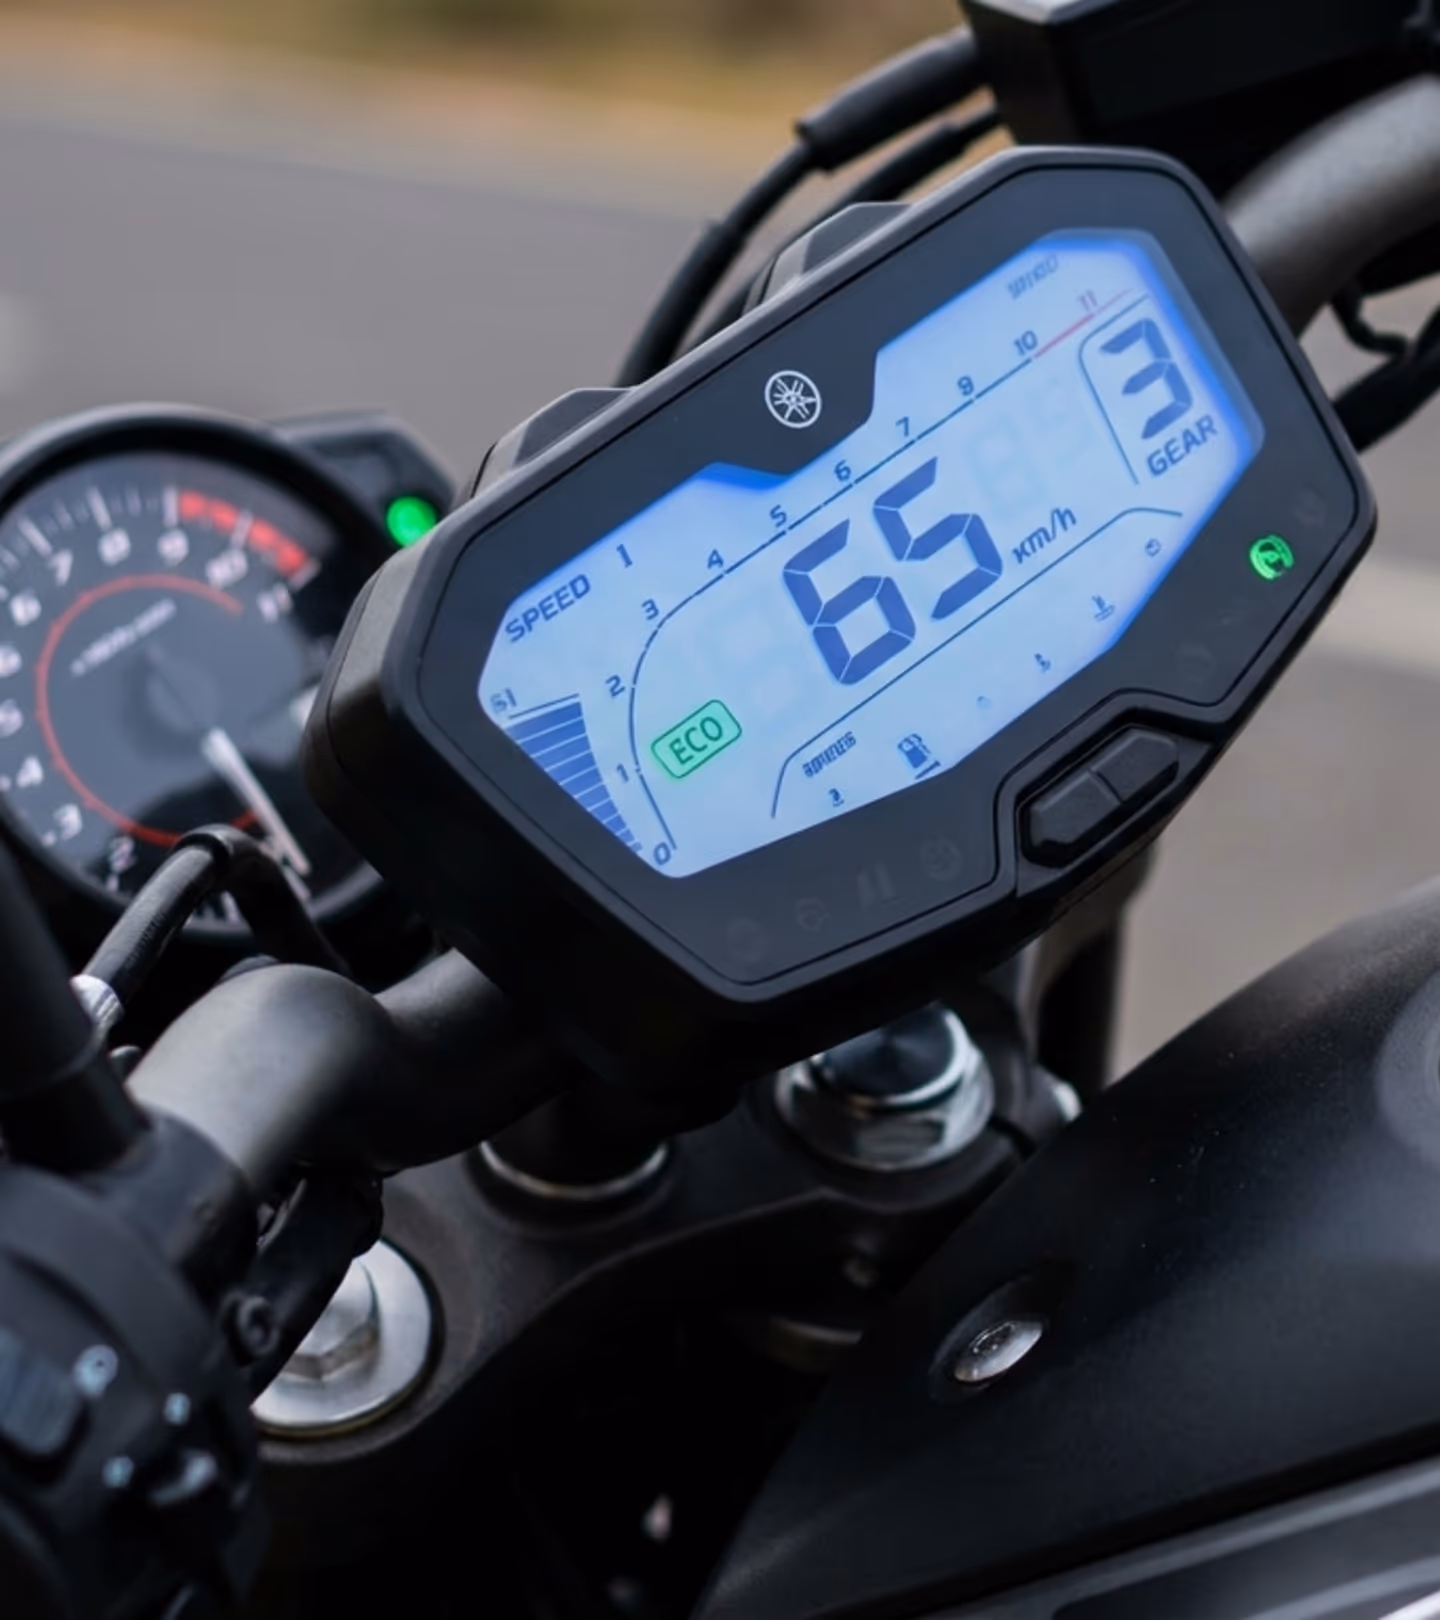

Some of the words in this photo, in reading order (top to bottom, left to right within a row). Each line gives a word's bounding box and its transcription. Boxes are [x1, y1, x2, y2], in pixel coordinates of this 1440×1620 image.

[1014, 330, 1038, 356] 10
[957, 375, 975, 396] 9
[1100, 317, 1193, 440] 3
[1146, 414, 1219, 477] GEAR
[834, 460, 852, 482] 6
[770, 505, 788, 528] 5
[616, 544, 633, 568] 1
[782, 456, 1003, 686] 65
[505, 573, 591, 642] SPEED
[641, 599, 659, 620] 3
[605, 675, 625, 697] 2
[668, 716, 724, 766] ECO
